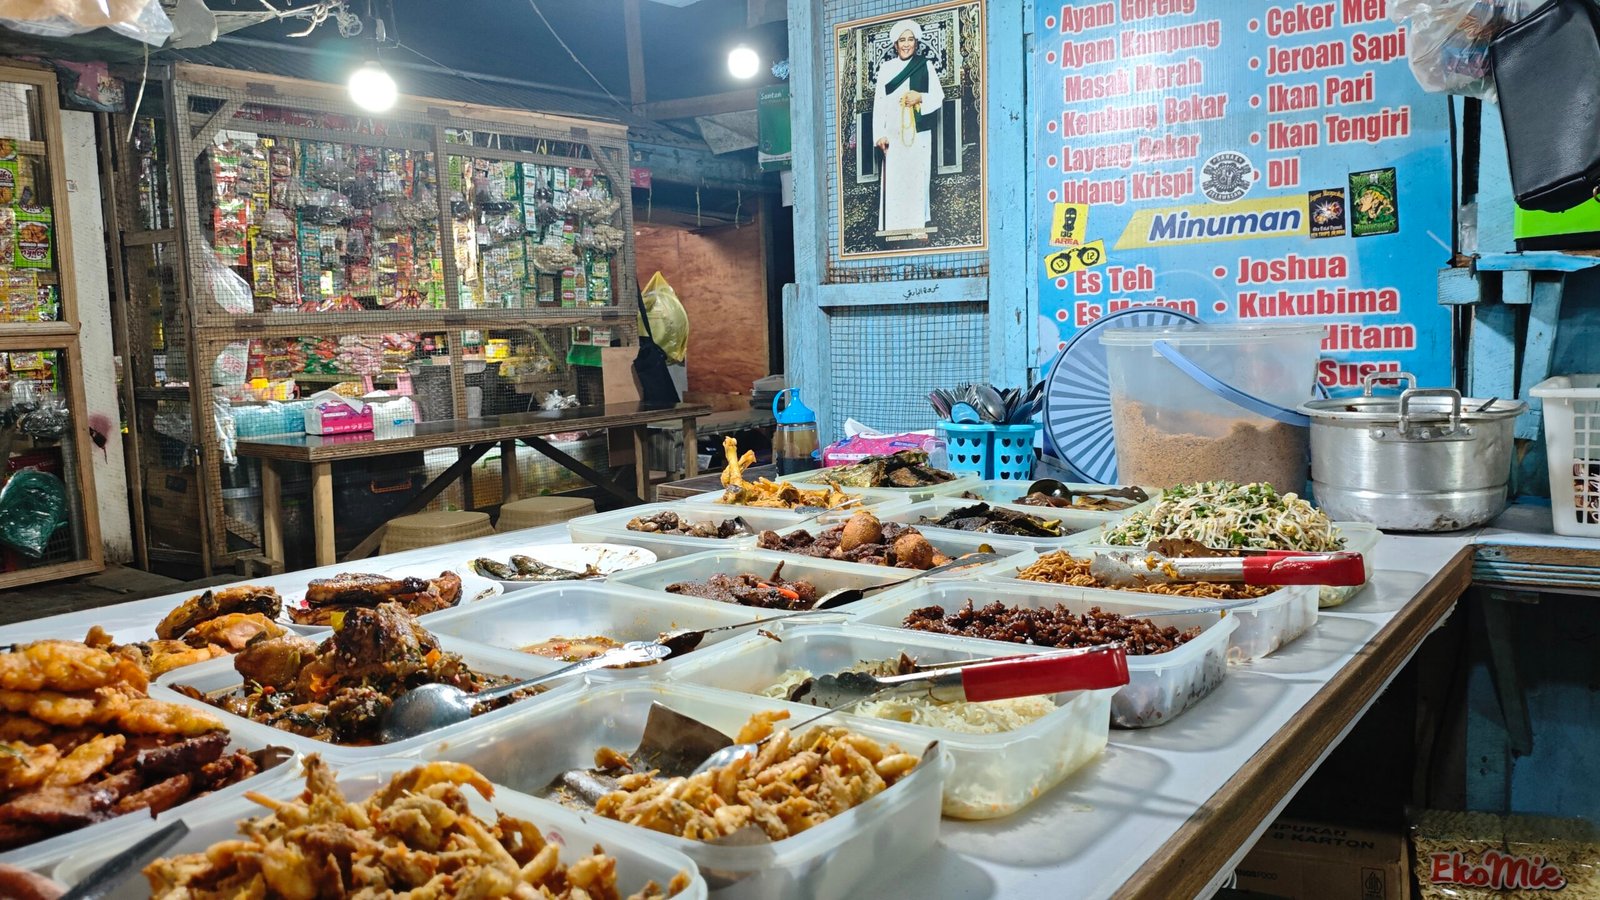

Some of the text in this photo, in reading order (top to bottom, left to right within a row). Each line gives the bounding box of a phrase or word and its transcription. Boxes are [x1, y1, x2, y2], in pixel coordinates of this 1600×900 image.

[1062, 3, 1114, 32] Ayam
[1267, 4, 1335, 36] Ceker
[1062, 21, 1219, 67] Ayam Kampung
[1267, 28, 1406, 74] Jeroan Sapi
[1065, 58, 1201, 102] Masak Merah
[1268, 73, 1373, 112] Ikan Pari
[1063, 95, 1227, 137] Kembung Bakar
[1268, 108, 1408, 149] Ikan Tengiri
[1064, 134, 1199, 172] Layang Bakar
[1064, 168, 1193, 204] Udang Krispi
[1149, 210, 1301, 241] Minuman
[1076, 266, 1153, 294] Es Teh
[1238, 255, 1346, 283] Joshua
[1076, 302, 1101, 326] Es
[1239, 289, 1398, 318] Kukubima
[1321, 324, 1414, 350] Hitam
[1318, 360, 1399, 386] Susu
[1291, 834, 1375, 849] KARTON
[1430, 851, 1563, 887] EkoMie
